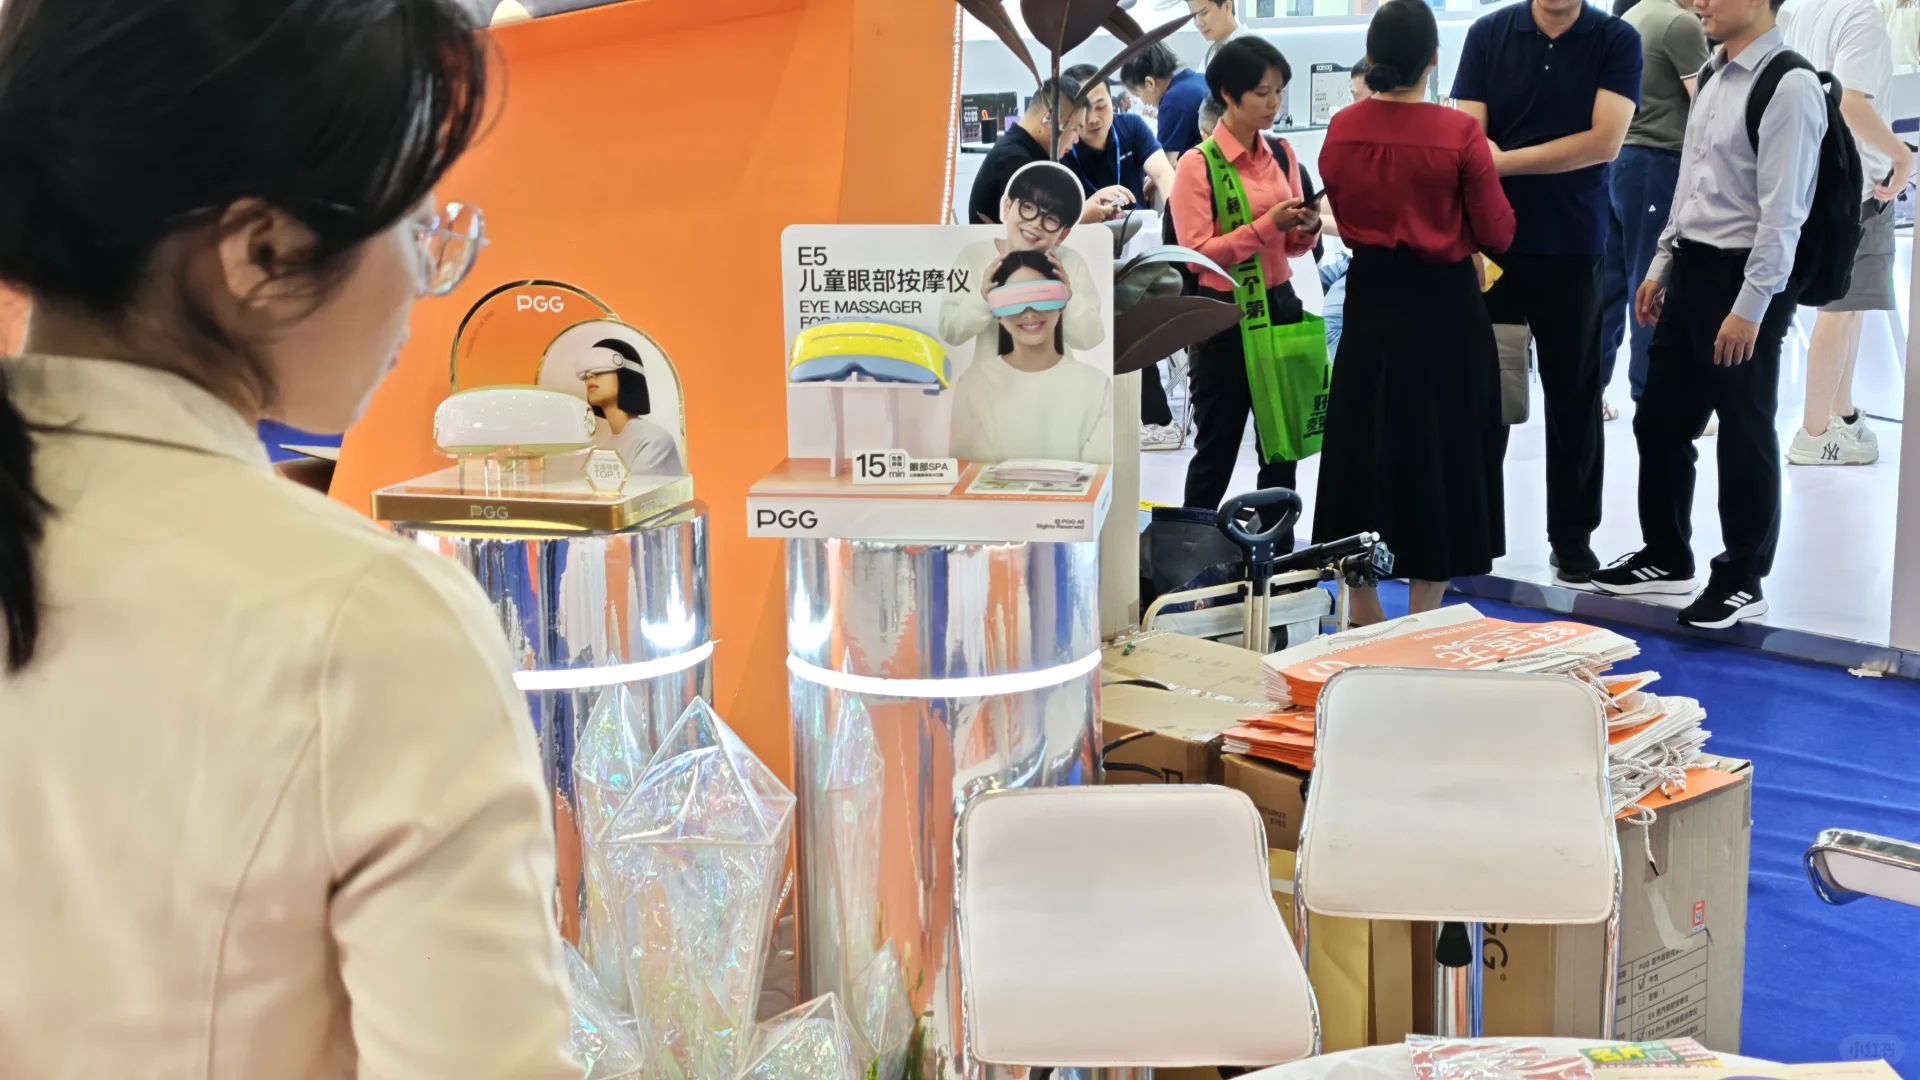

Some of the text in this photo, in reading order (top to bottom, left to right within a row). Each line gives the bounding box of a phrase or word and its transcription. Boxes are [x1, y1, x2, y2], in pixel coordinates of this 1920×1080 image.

[798, 246, 828, 266] E5
[799, 268, 971, 294] 儿童眼部按摩仪
[516, 295, 564, 313] PGG
[799, 300, 922, 314] EYE MASSAGER
[856, 453, 886, 478] 15
[889, 469, 905, 478] min
[470, 504, 509, 520] PGG
[757, 509, 819, 529] PGG
